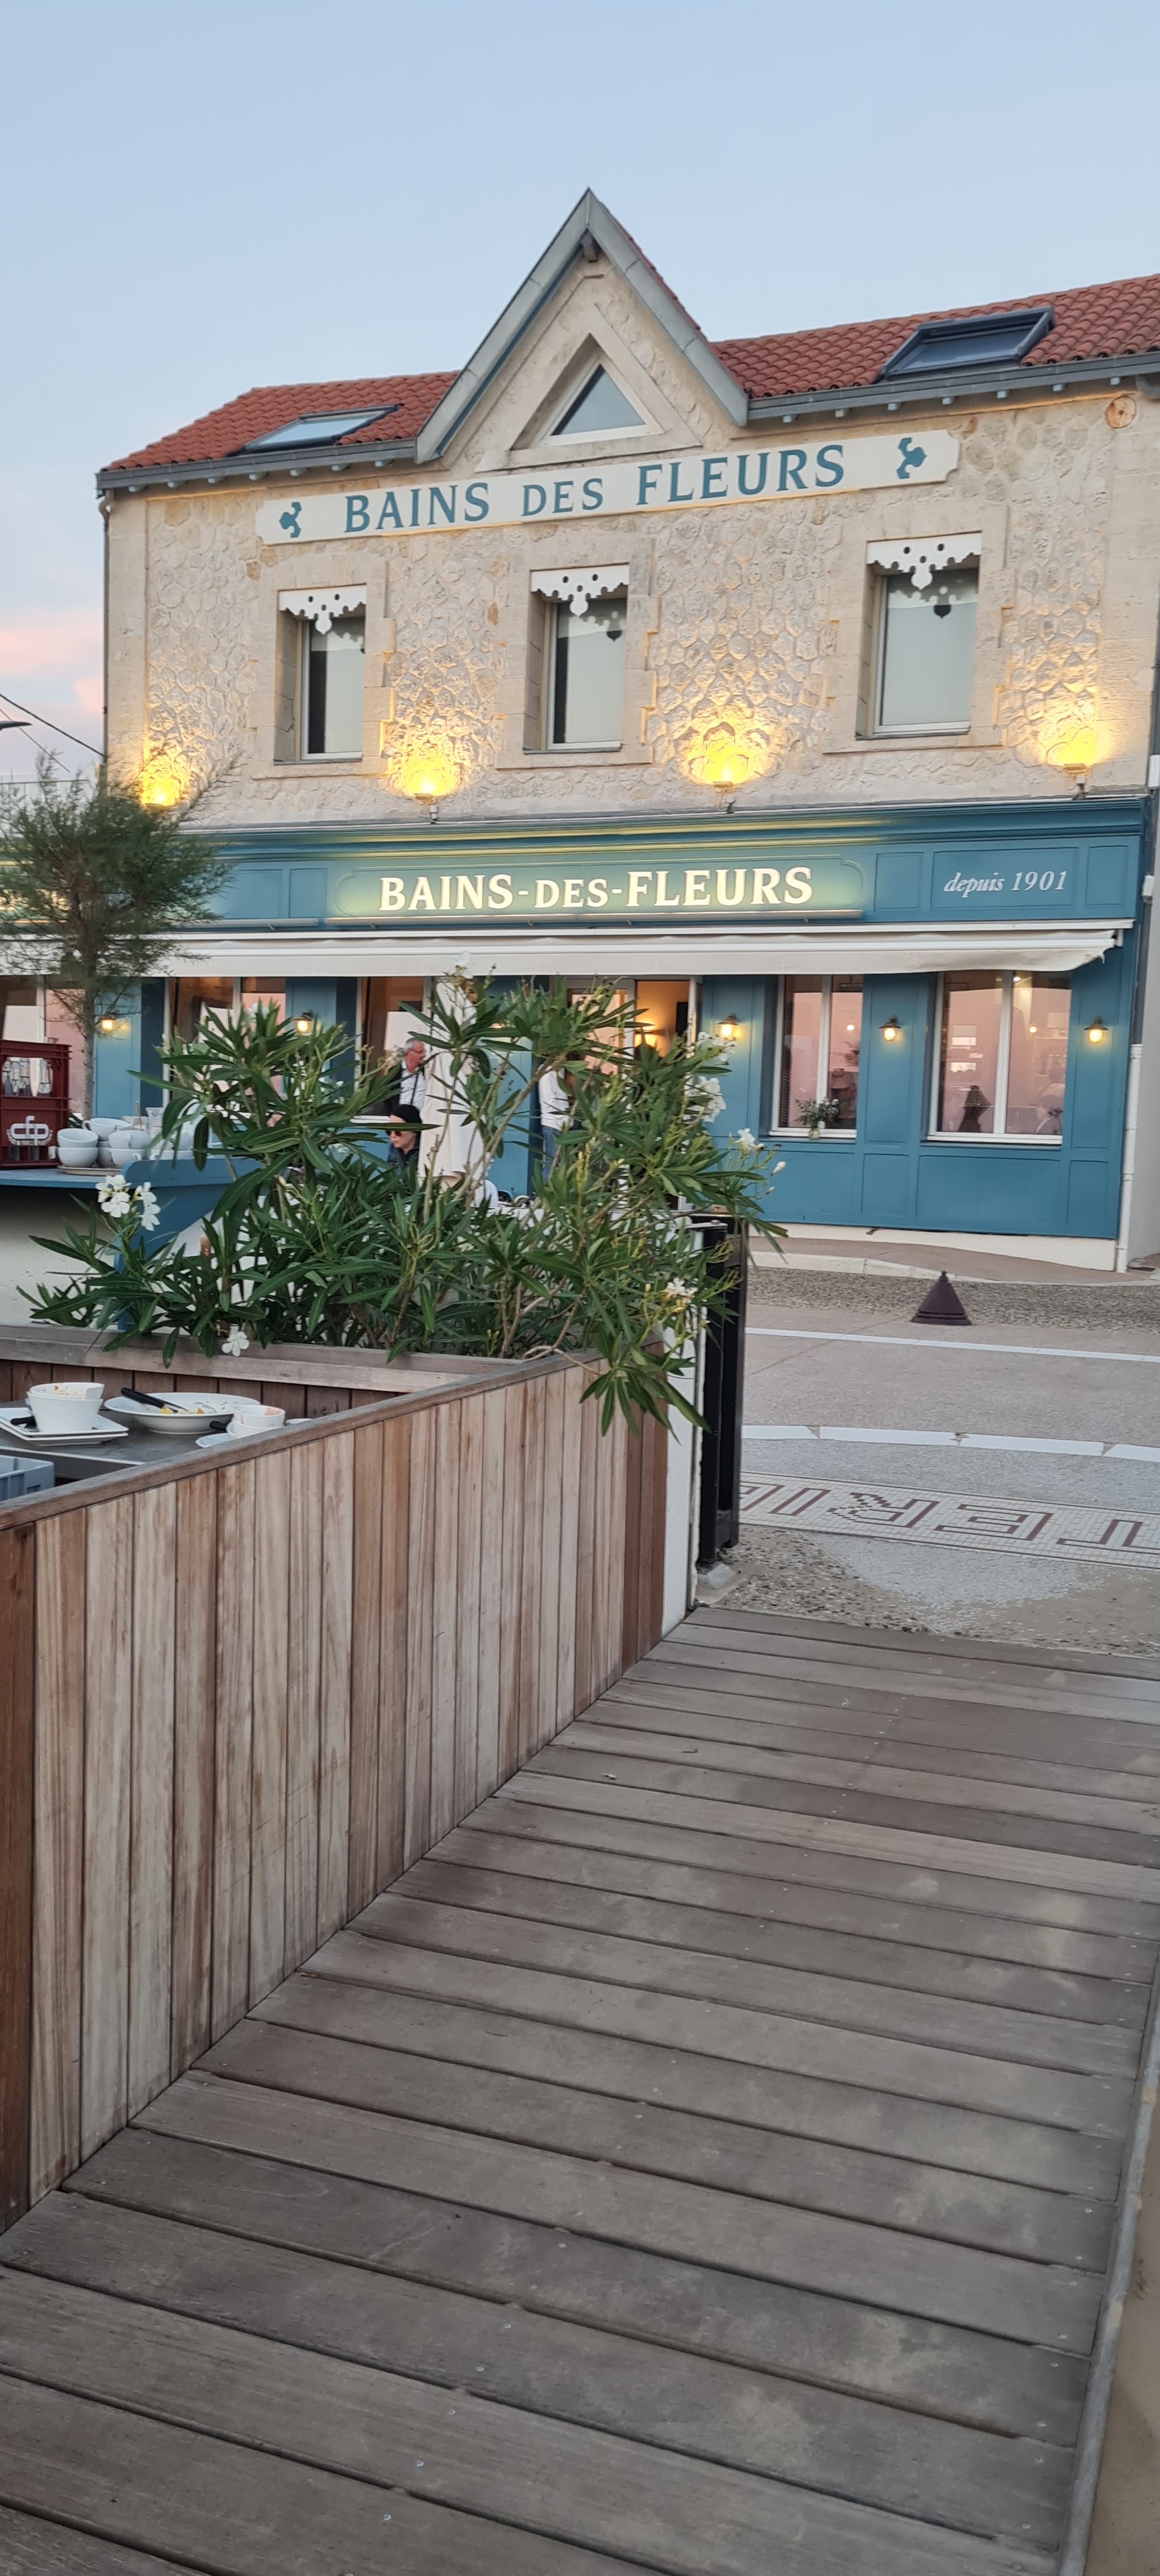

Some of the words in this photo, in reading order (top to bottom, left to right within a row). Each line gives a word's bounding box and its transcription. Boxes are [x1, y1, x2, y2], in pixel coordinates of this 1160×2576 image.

[344, 481, 489, 533] BAINS
[521, 477, 604, 516] DES
[636, 444, 844, 505] FLEURS
[379, 866, 813, 911] BAINS-DES-FLEURS
[943, 871, 1005, 898] depuis
[1011, 870, 1067, 891] 1901
